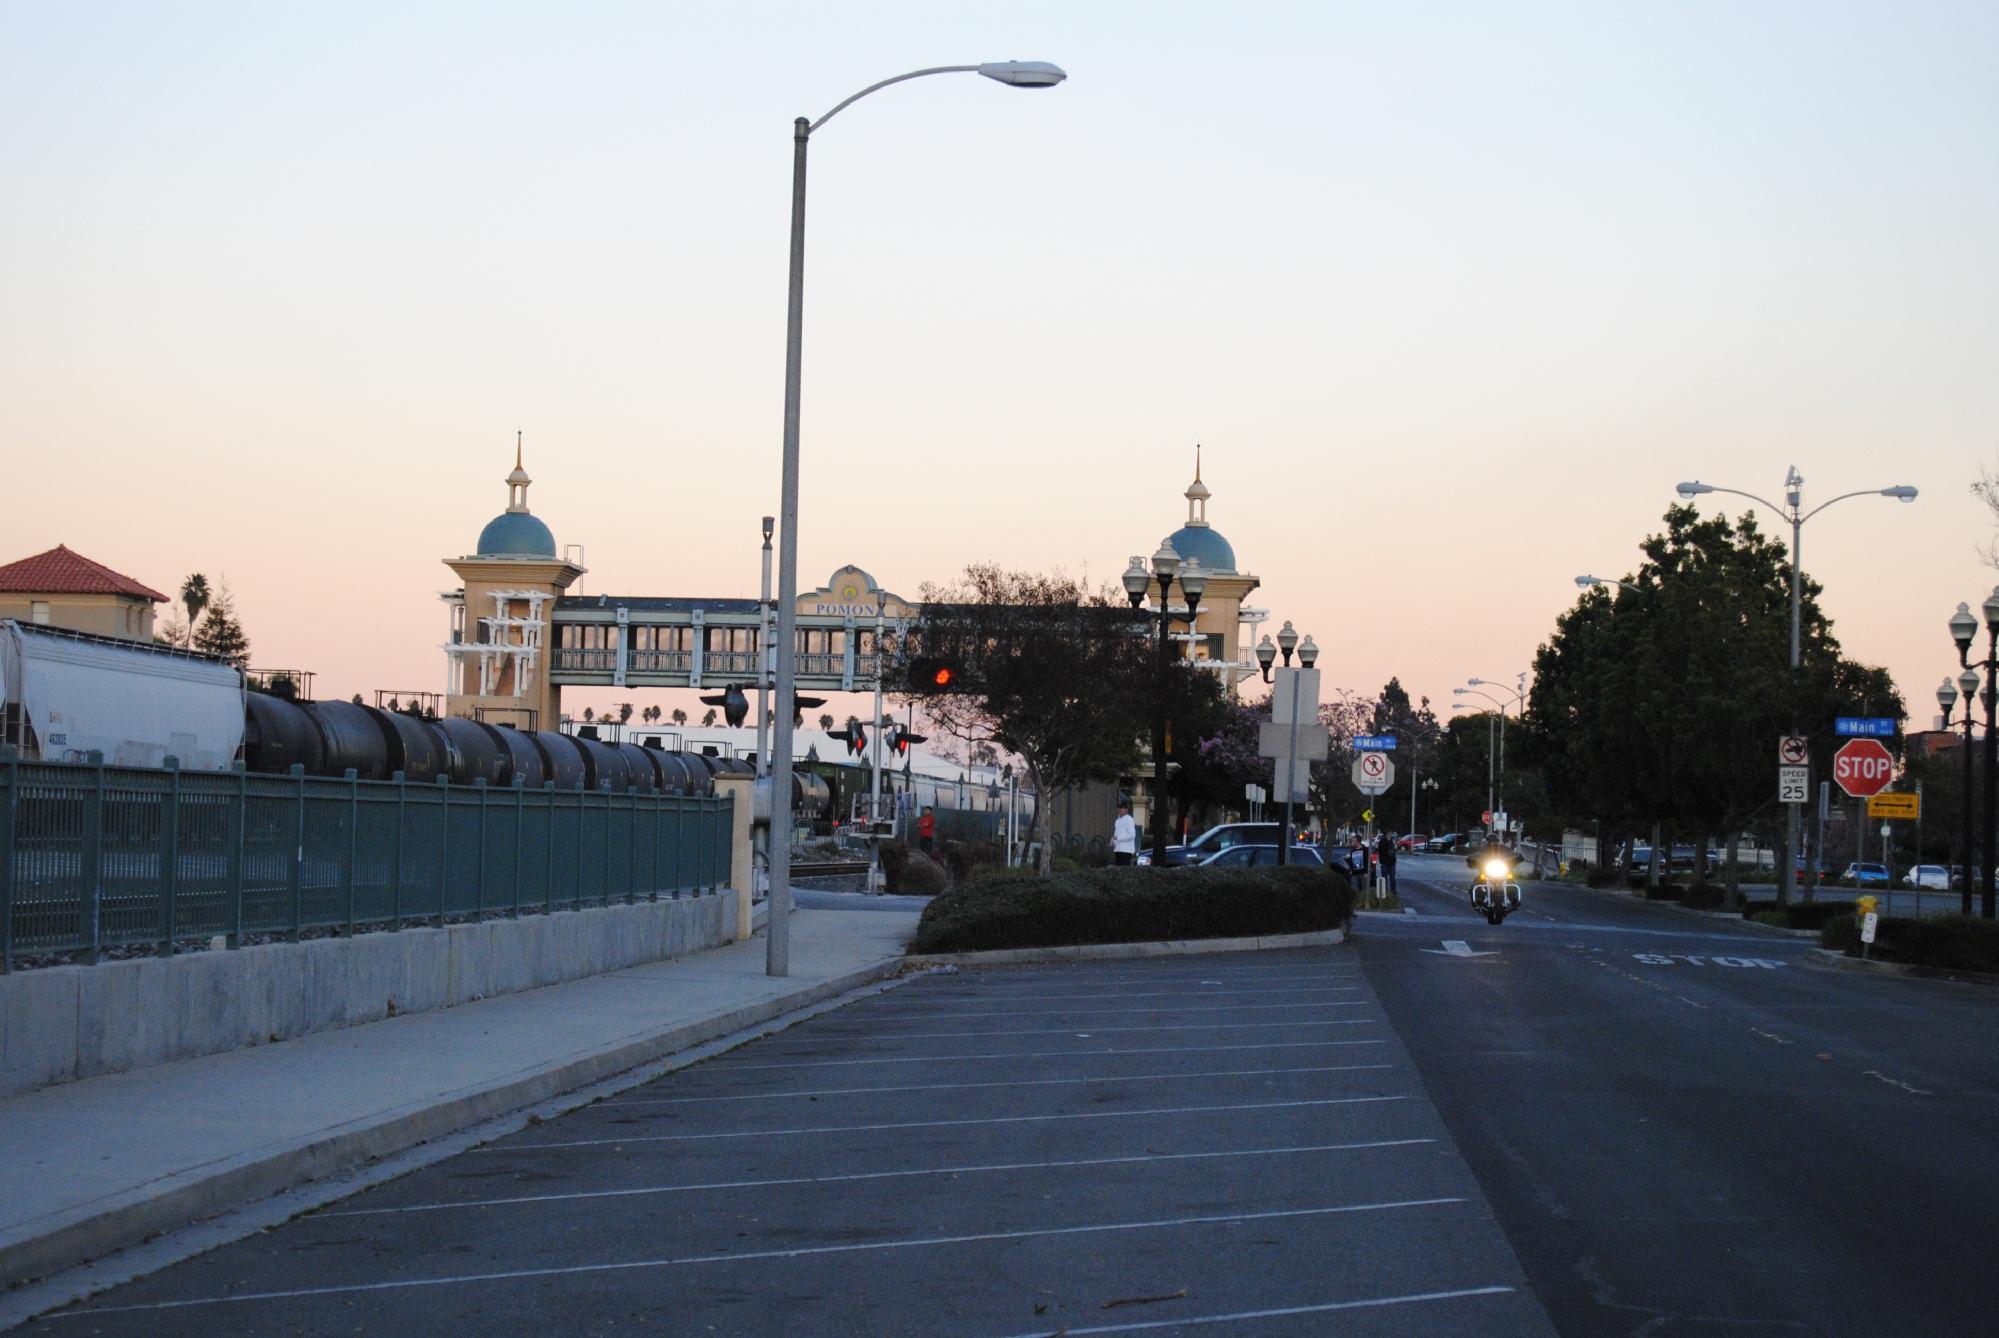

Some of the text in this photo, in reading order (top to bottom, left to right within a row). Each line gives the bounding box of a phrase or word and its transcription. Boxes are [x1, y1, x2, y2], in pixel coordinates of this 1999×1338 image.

[816, 604, 882, 616] POMON
[1850, 721, 1875, 733] Main
[1363, 738, 1382, 748] Main
[1838, 757, 1890, 779] STOP
[1783, 785, 1804, 799] 25
[1632, 954, 1788, 969] STOP
